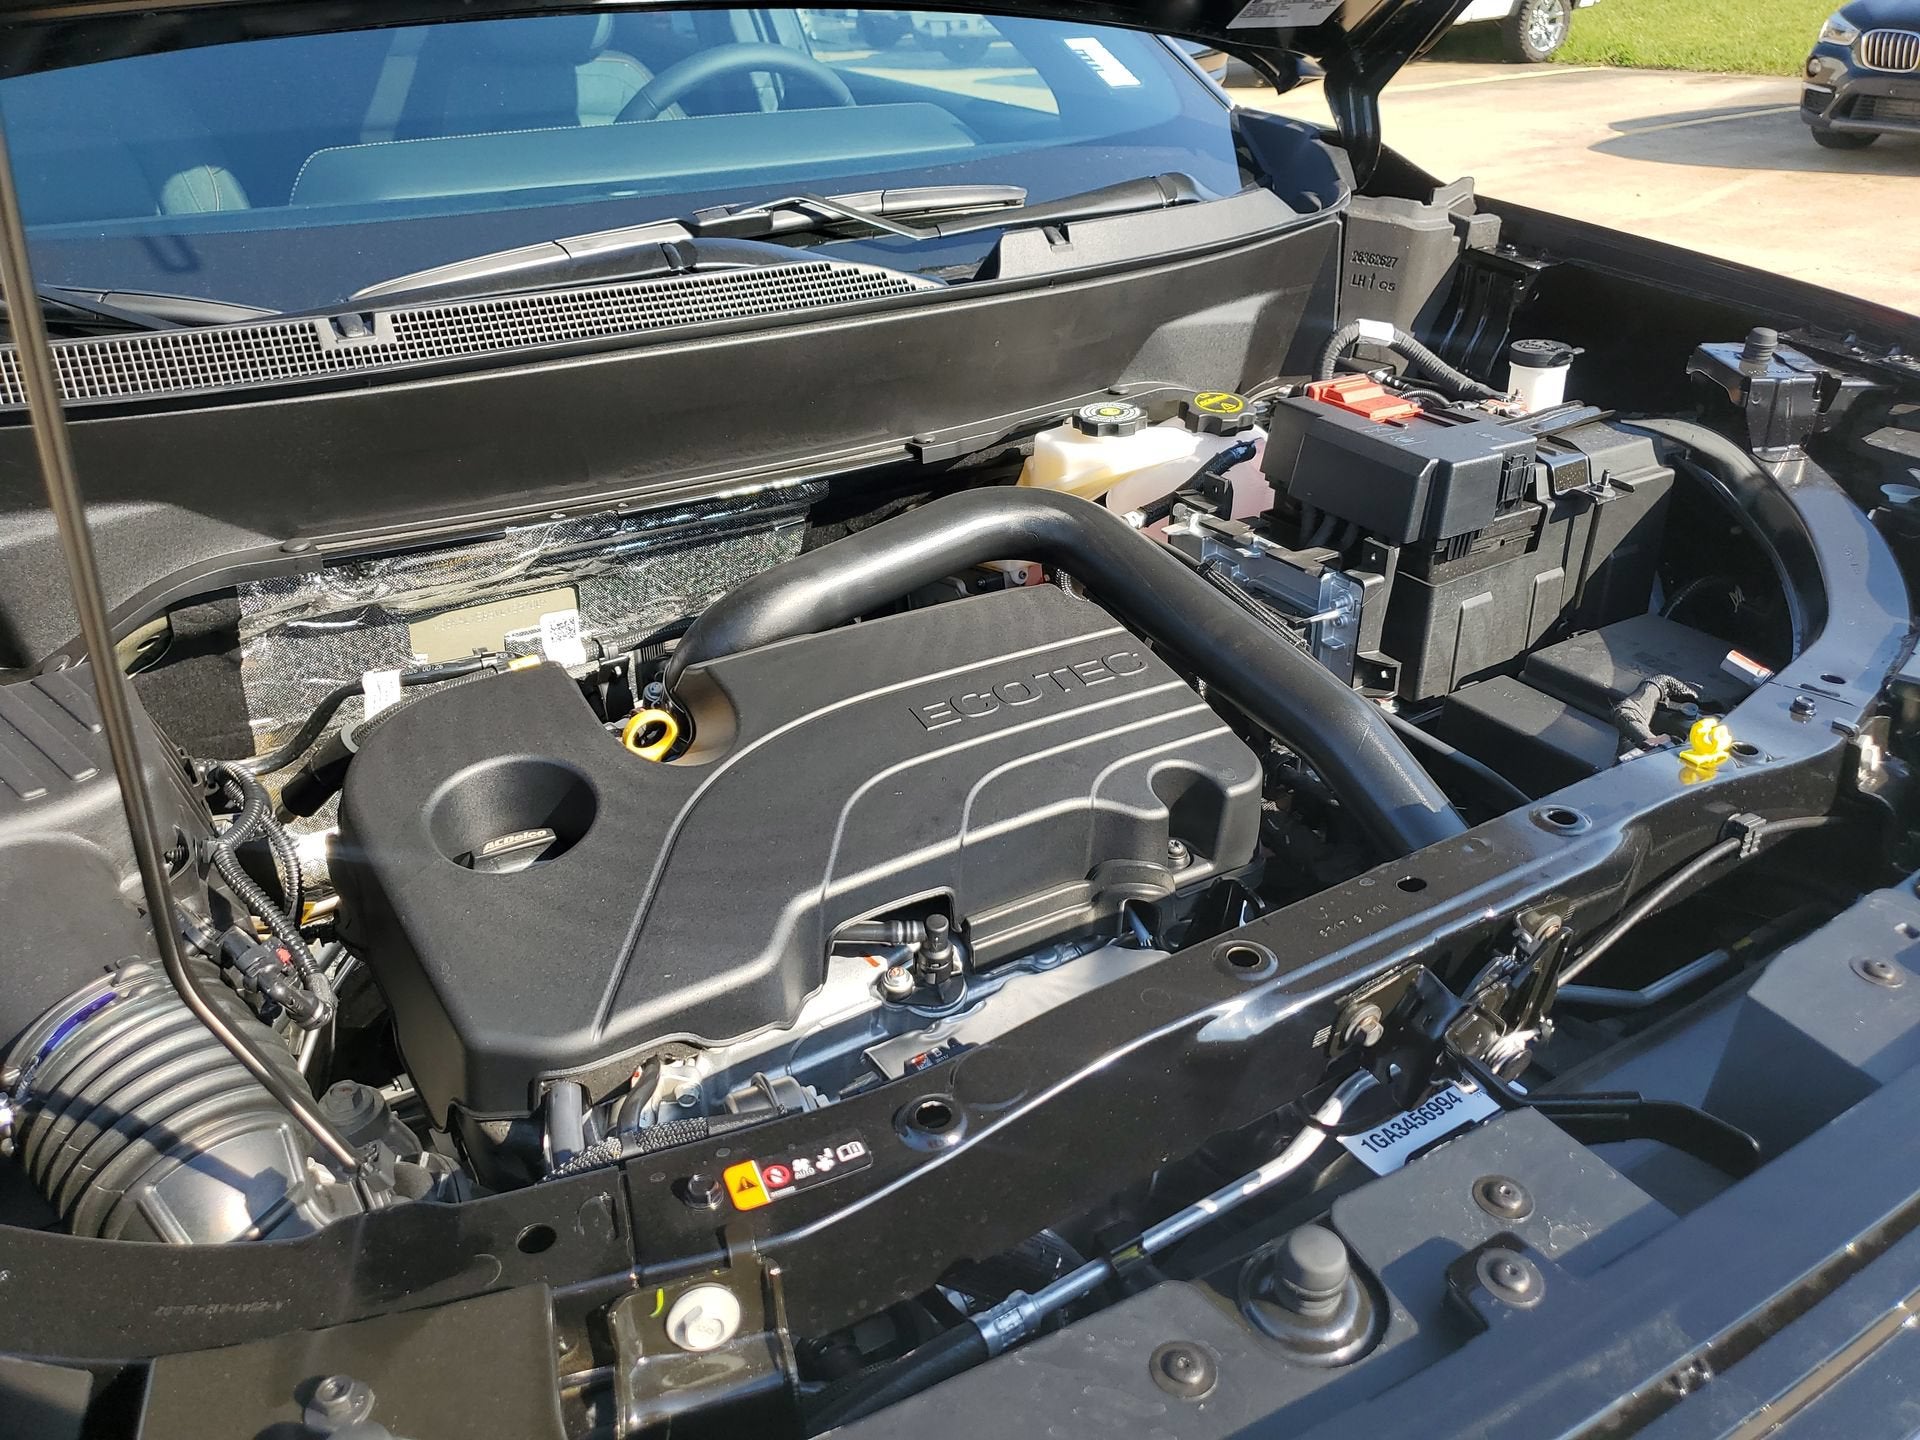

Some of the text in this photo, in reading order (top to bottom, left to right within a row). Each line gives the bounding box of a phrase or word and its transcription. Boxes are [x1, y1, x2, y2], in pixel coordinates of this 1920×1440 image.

[1350, 273, 1366, 288] LH
[908, 652, 1147, 731] ECOTEC
[482, 830, 547, 854] ACDelco
[1361, 1090, 1463, 1153] 1GA3456994
